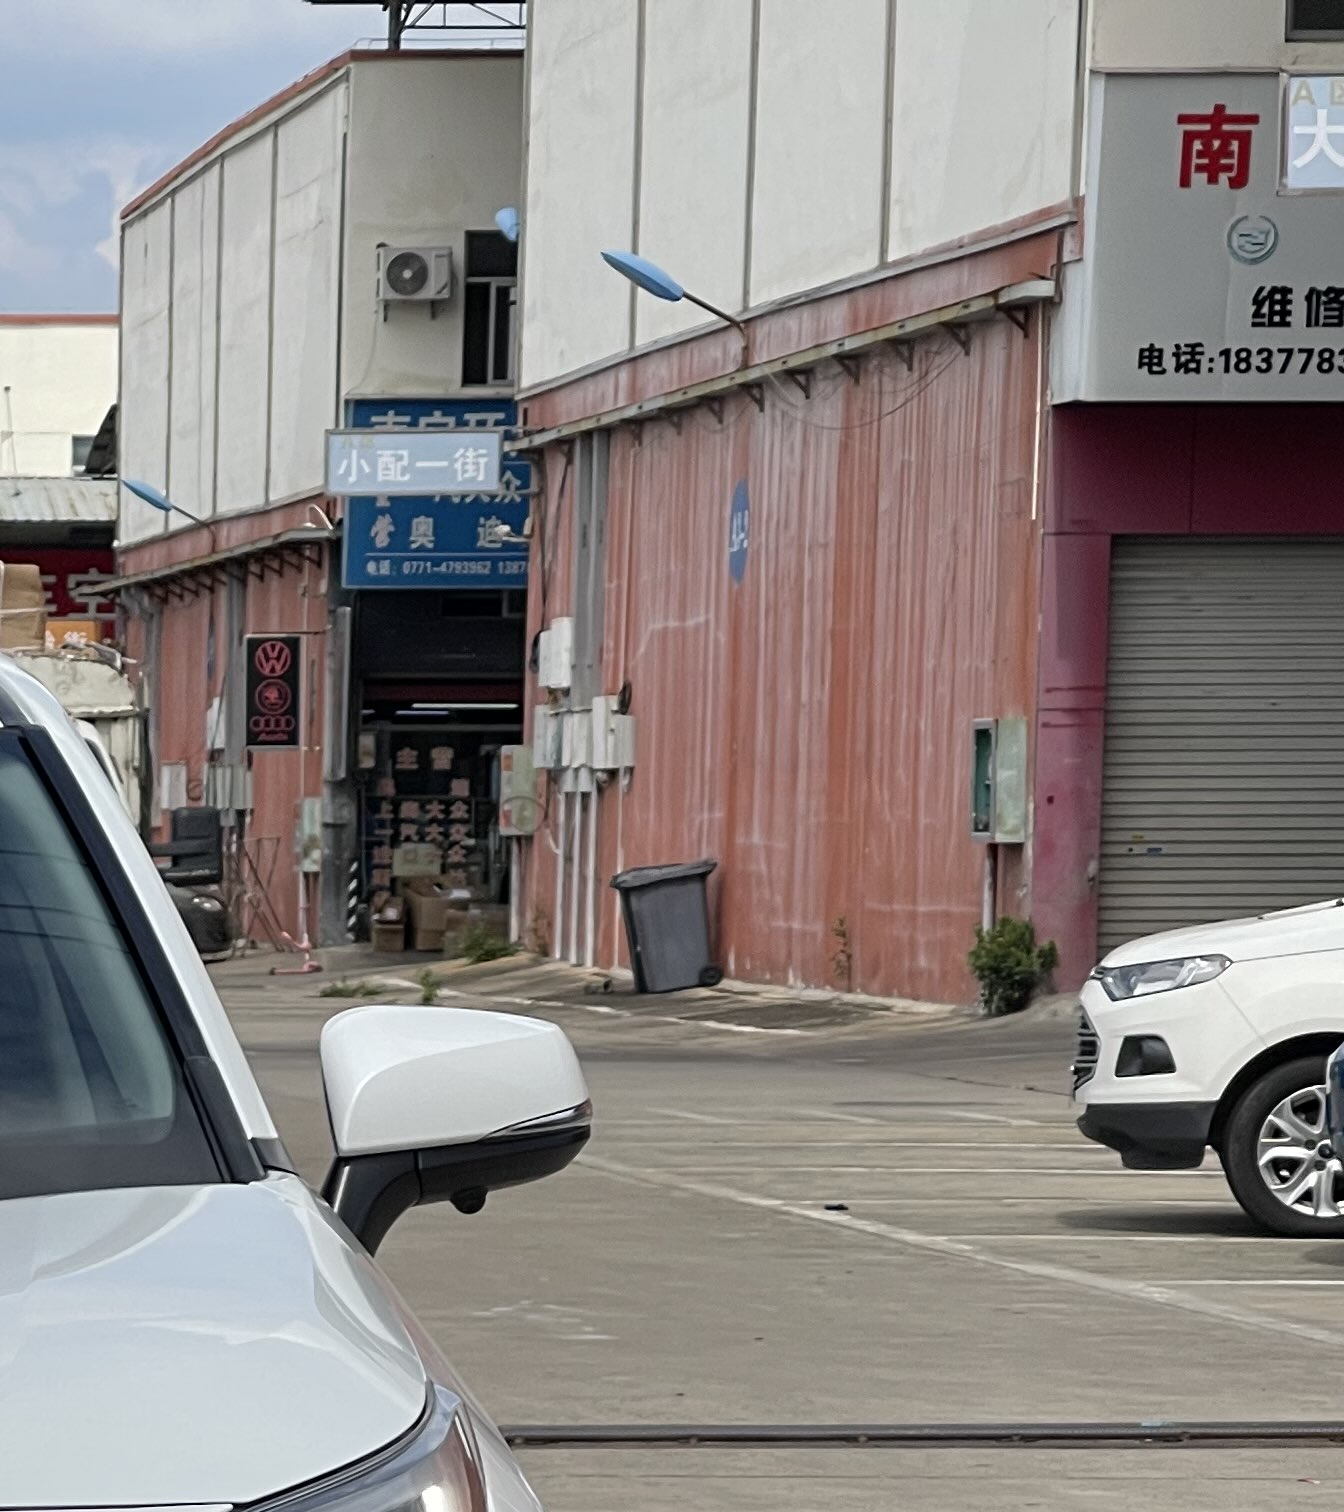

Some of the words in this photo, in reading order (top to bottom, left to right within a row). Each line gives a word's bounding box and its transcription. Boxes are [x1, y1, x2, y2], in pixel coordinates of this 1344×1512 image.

[1176, 103, 1260, 190] 南
[337, 447, 489, 484] 小配一街
